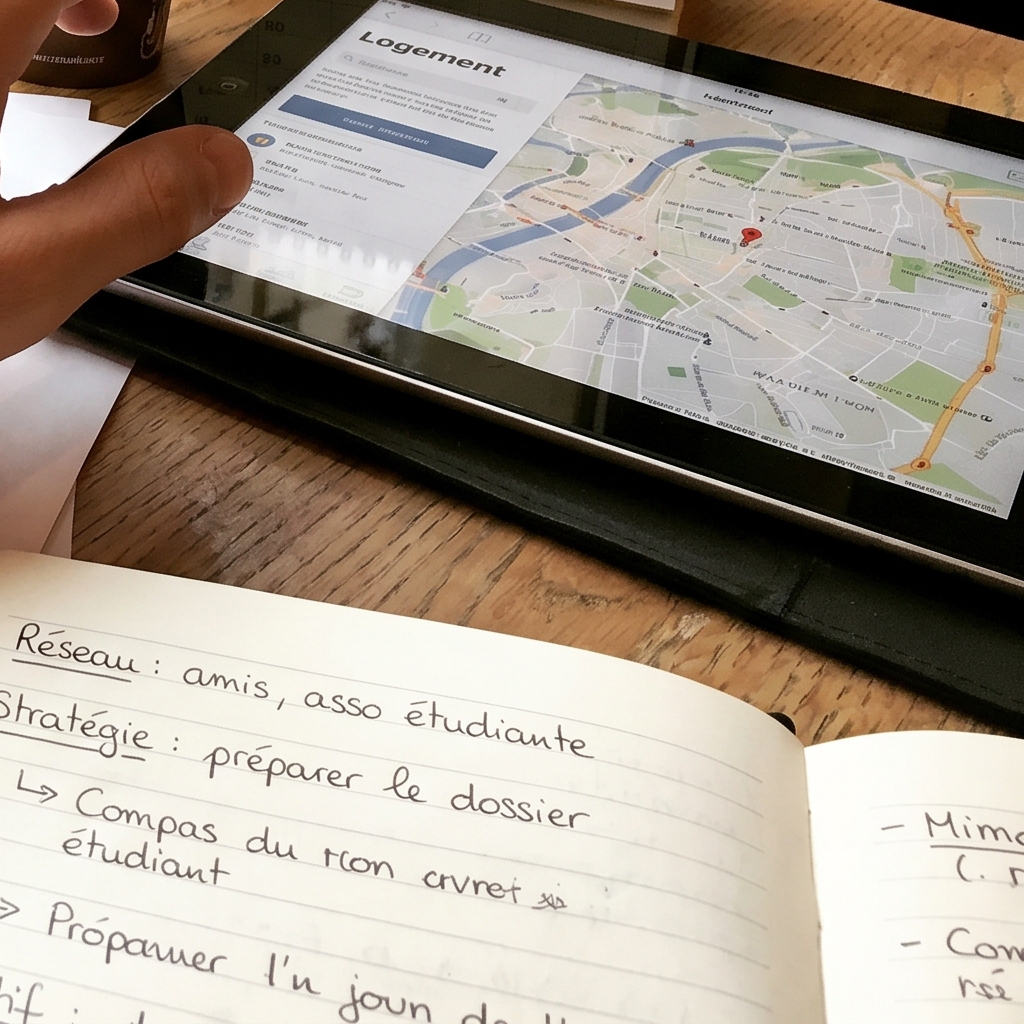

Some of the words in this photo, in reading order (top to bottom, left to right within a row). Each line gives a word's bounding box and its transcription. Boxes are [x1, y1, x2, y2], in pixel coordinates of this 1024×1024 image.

[358, 30, 507, 80] Logement
[15, 622, 141, 676] Réseau
[182, 665, 286, 712] amis,
[304, 689, 383, 720] asso
[405, 700, 596, 760] étudiante
[203, 742, 364, 791] préparer
[384, 765, 428, 805] le
[450, 784, 591, 830] dossier
[61, 827, 230, 885] étudiant
[75, 787, 219, 846] Compas
[246, 826, 298, 861] du
